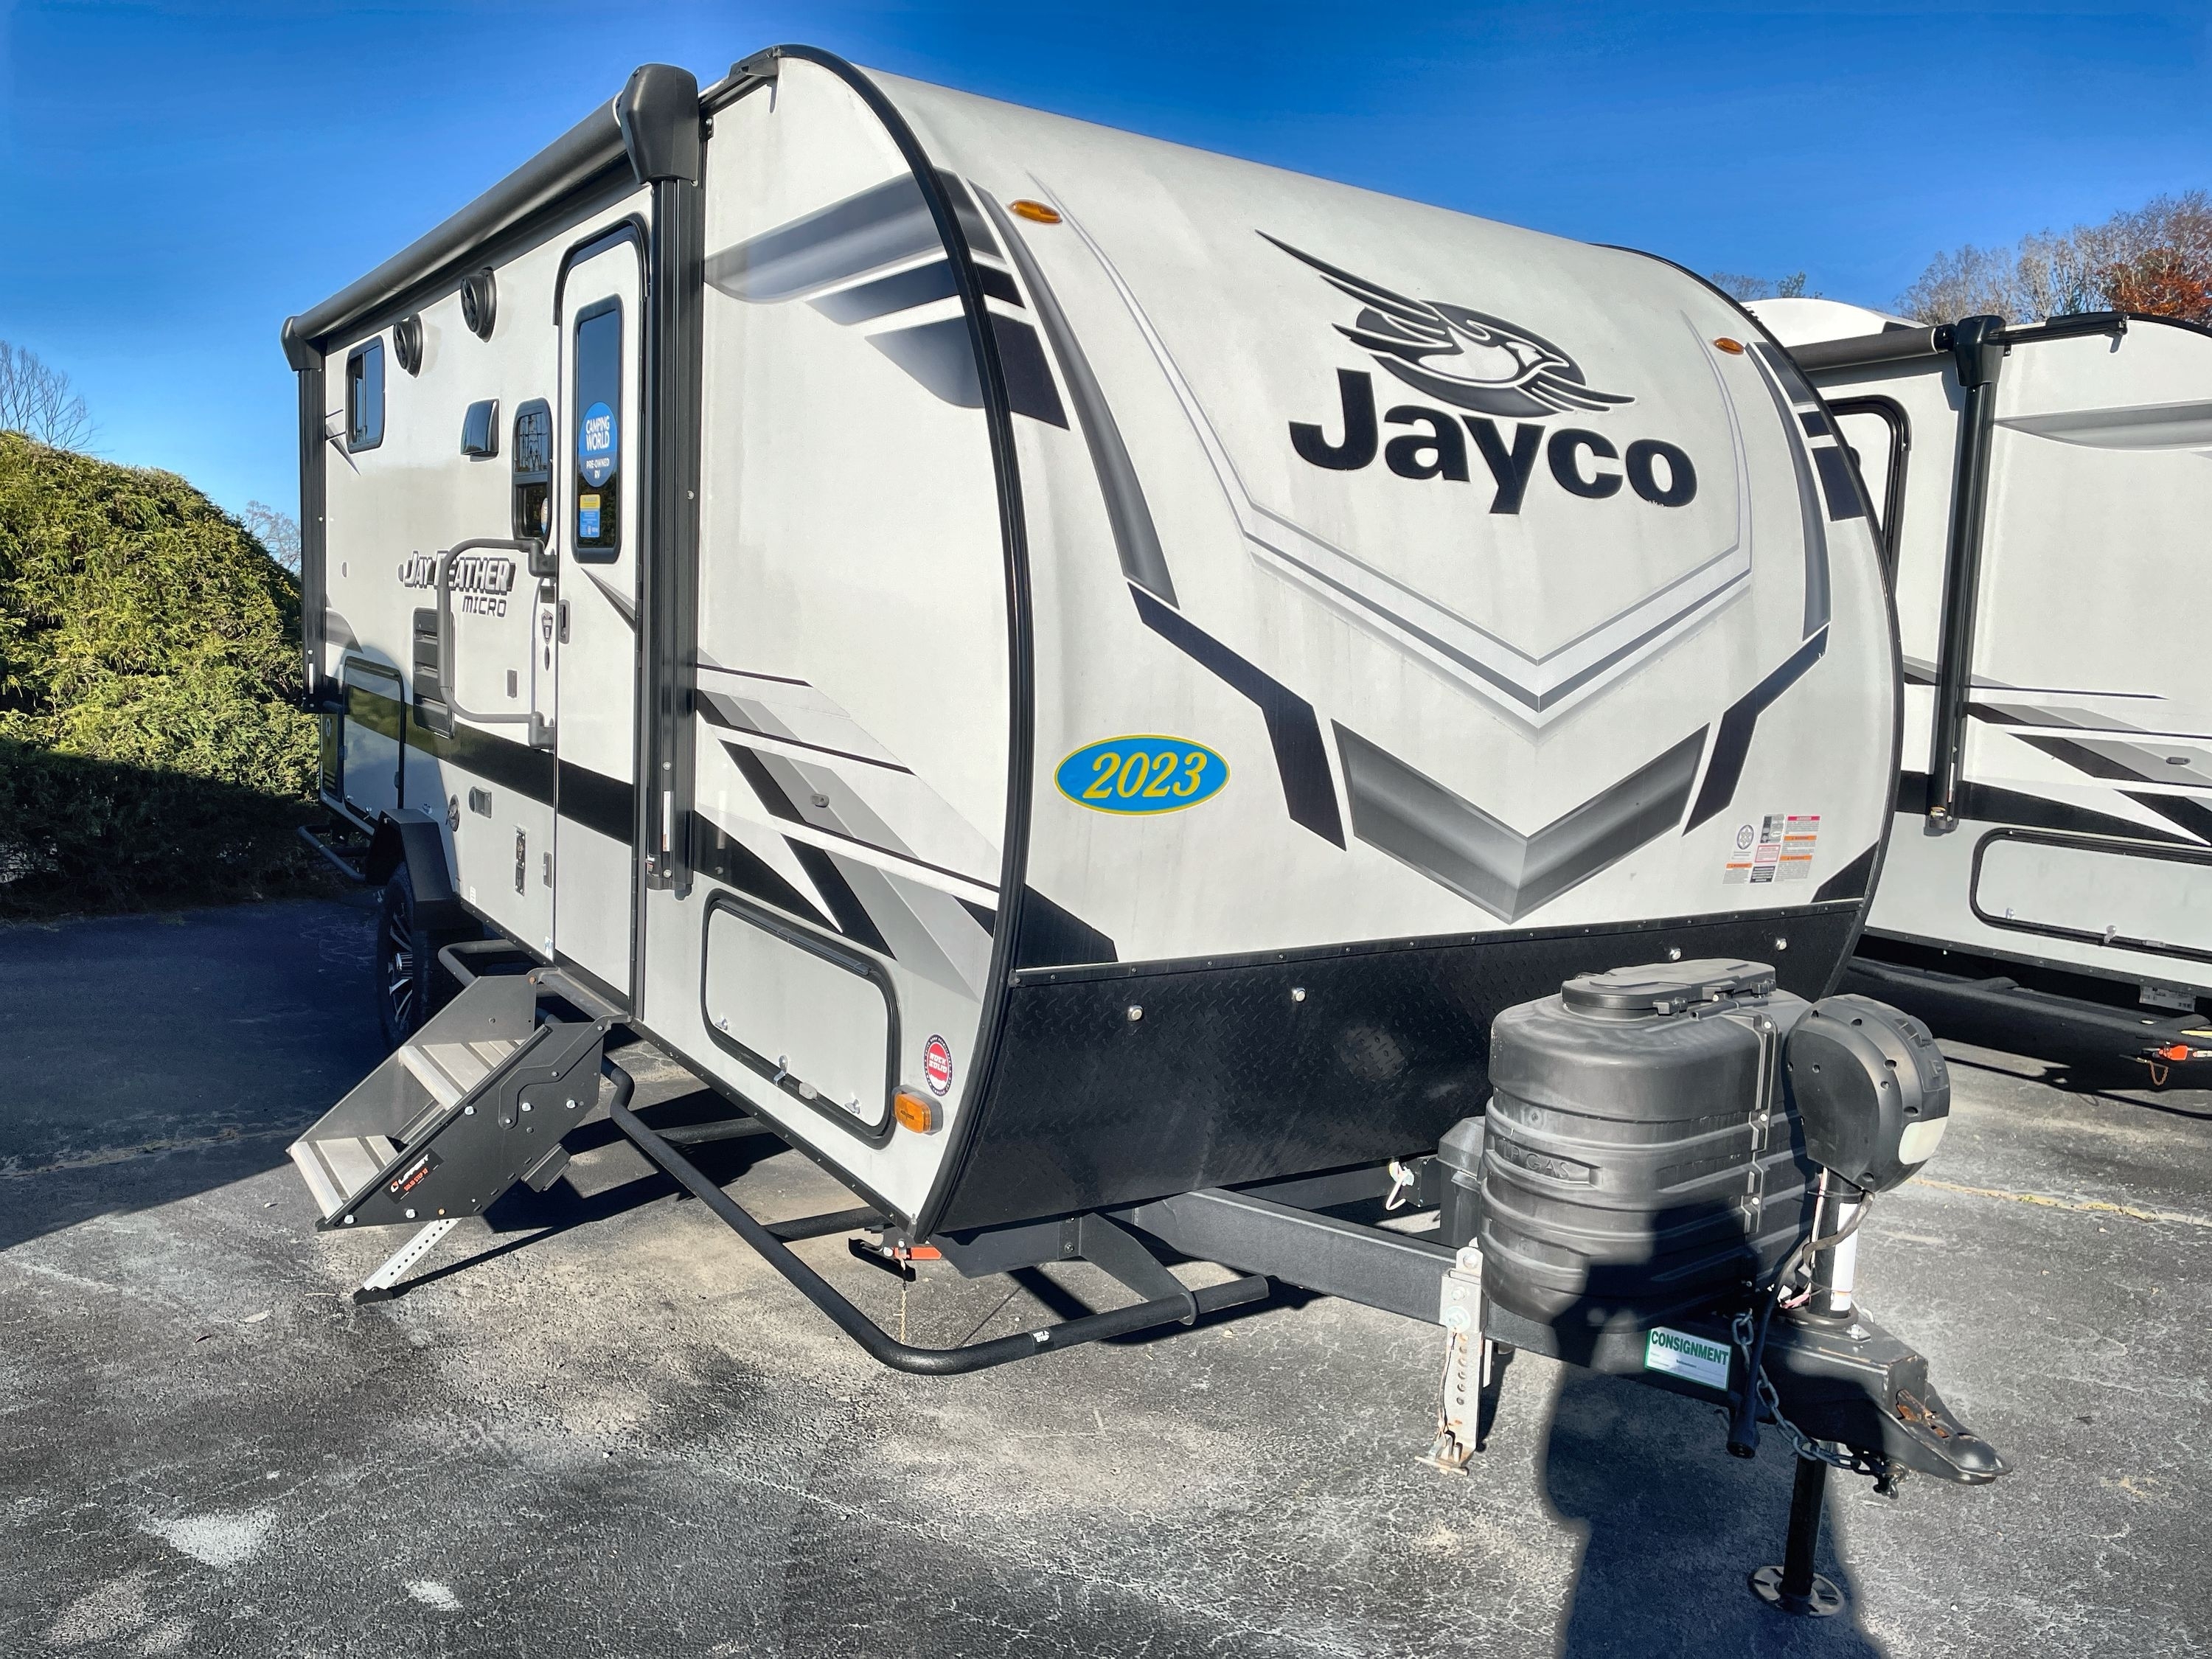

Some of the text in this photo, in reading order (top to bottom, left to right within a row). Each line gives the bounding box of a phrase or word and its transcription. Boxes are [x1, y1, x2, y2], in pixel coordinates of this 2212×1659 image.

[585, 415, 611, 434] CAMPING
[585, 433, 611, 451] WORLD
[1288, 366, 1698, 515] Jayco
[586, 458, 611, 470] PRE-OWNED
[594, 470, 601, 479] RV
[462, 595, 507, 618] MICRO
[1082, 751, 1208, 799] 2023
[928, 1060, 947, 1074] SOLID
[929, 1052, 947, 1066] ROCK
[398, 1153, 430, 1185] LIPPERT
[1526, 1152, 1569, 1180] GAS
[1652, 1330, 1728, 1366] CONSIGNMENT
